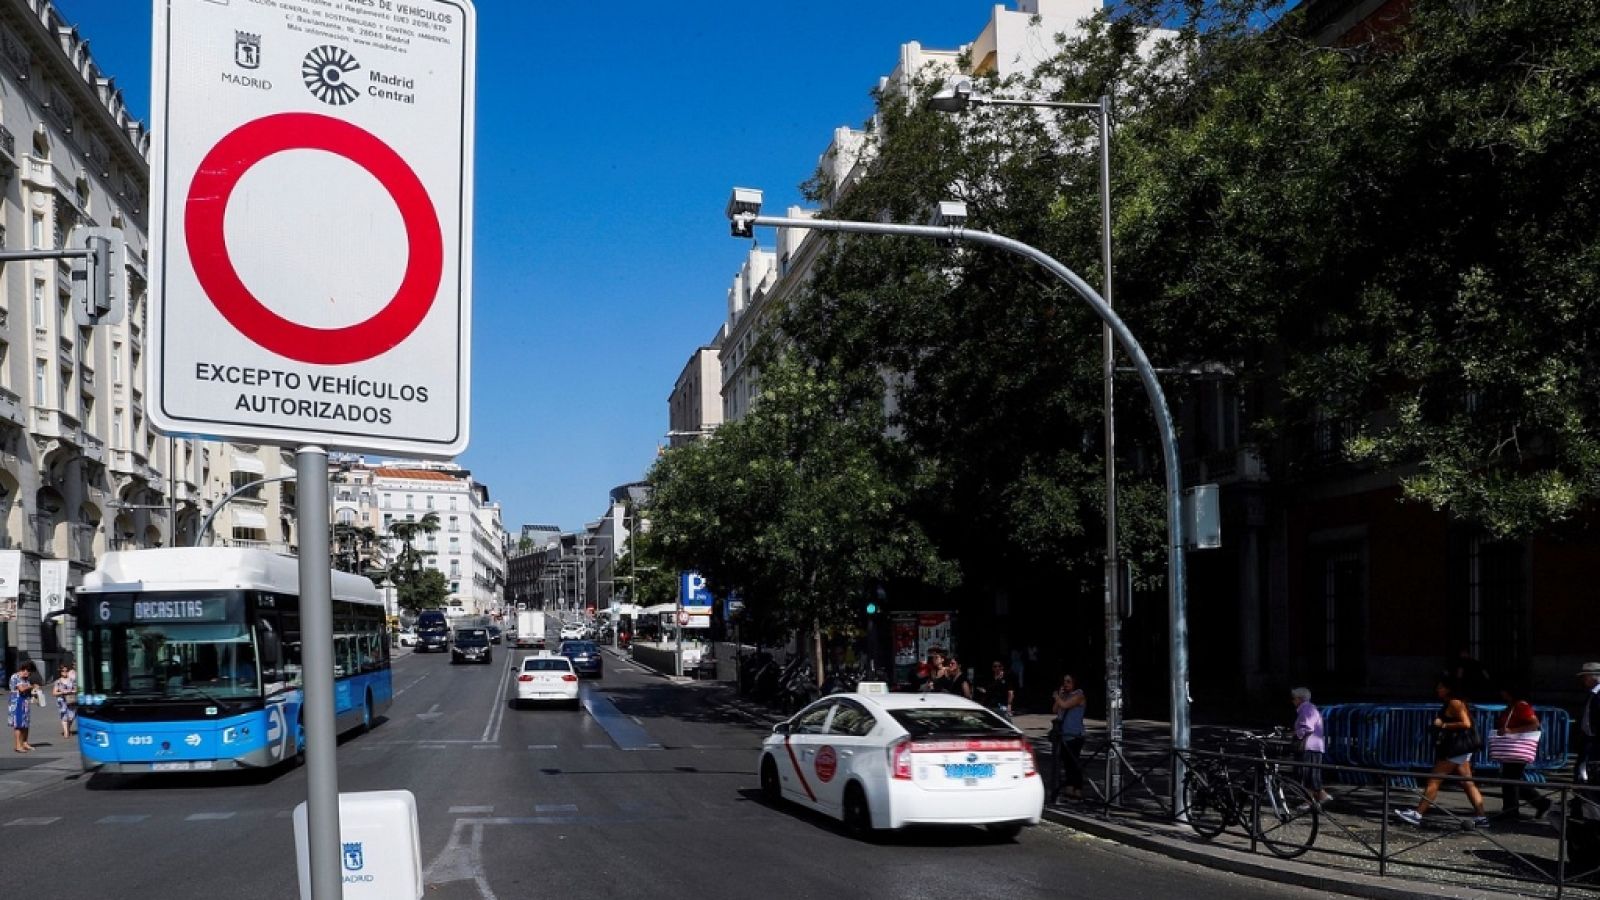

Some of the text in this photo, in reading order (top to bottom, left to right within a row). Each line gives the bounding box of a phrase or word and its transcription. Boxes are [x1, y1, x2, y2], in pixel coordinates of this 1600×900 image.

[379, 0, 392, 11] DE
[396, 4, 452, 24] VEHÍCULOS
[221, 71, 273, 90] MADRID
[369, 70, 414, 90] Madrid
[368, 85, 415, 104] Central
[196, 362, 429, 403] EXCEPTO VEHÍCULOS
[234, 393, 392, 424] AUTORIZADOS
[688, 573, 707, 600] P
[99, 600, 203, 620] 6 ORCASITAS
